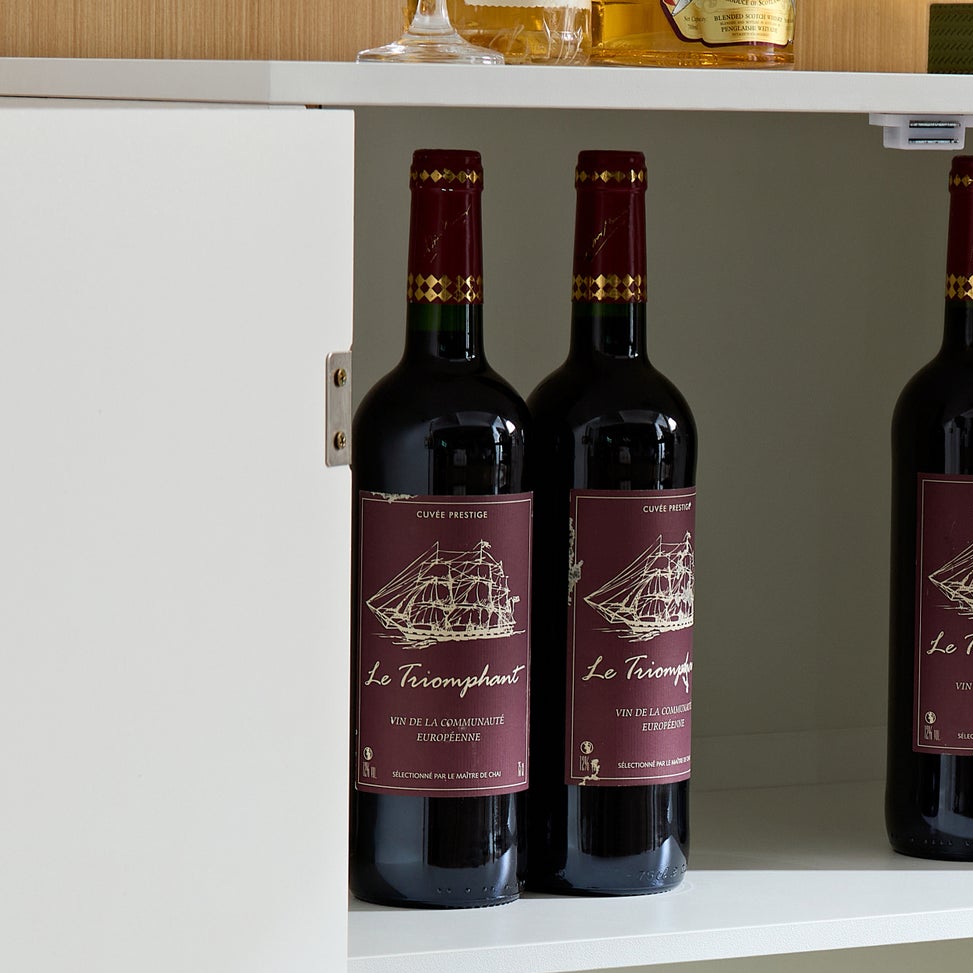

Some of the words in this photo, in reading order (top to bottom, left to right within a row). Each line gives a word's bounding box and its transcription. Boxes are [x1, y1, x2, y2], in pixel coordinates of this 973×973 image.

[713, 13, 744, 22] BLENDED
[745, 13, 766, 21] SCOTCH
[642, 504, 667, 513] CUVÉE
[416, 510, 446, 519] CUVÉE
[448, 511, 488, 519] PRESTIGE
[926, 631, 957, 655] Le
[581, 655, 617, 681] Le
[364, 661, 392, 686] Le
[398, 663, 525, 698] Triomphant
[955, 682, 972, 691] VIN
[615, 708, 632, 717] VIN
[635, 708, 647, 717] DE
[649, 707, 660, 716] LA
[389, 716, 406, 725] VIN
[409, 717, 422, 727] DE
[425, 718, 438, 727] LA
[440, 714, 505, 727] COMMUNAUTÉ
[416, 731, 481, 742] EUROPÉENNE
[618, 760, 656, 769] SÉLECTIONNÉ
[656, 759, 666, 767] PAR
[392, 770, 433, 779] SÉLECTIONNÉ
[434, 771, 447, 779] PAR
[448, 771, 454, 779] LE
[456, 770, 479, 779] MAÎTRE
